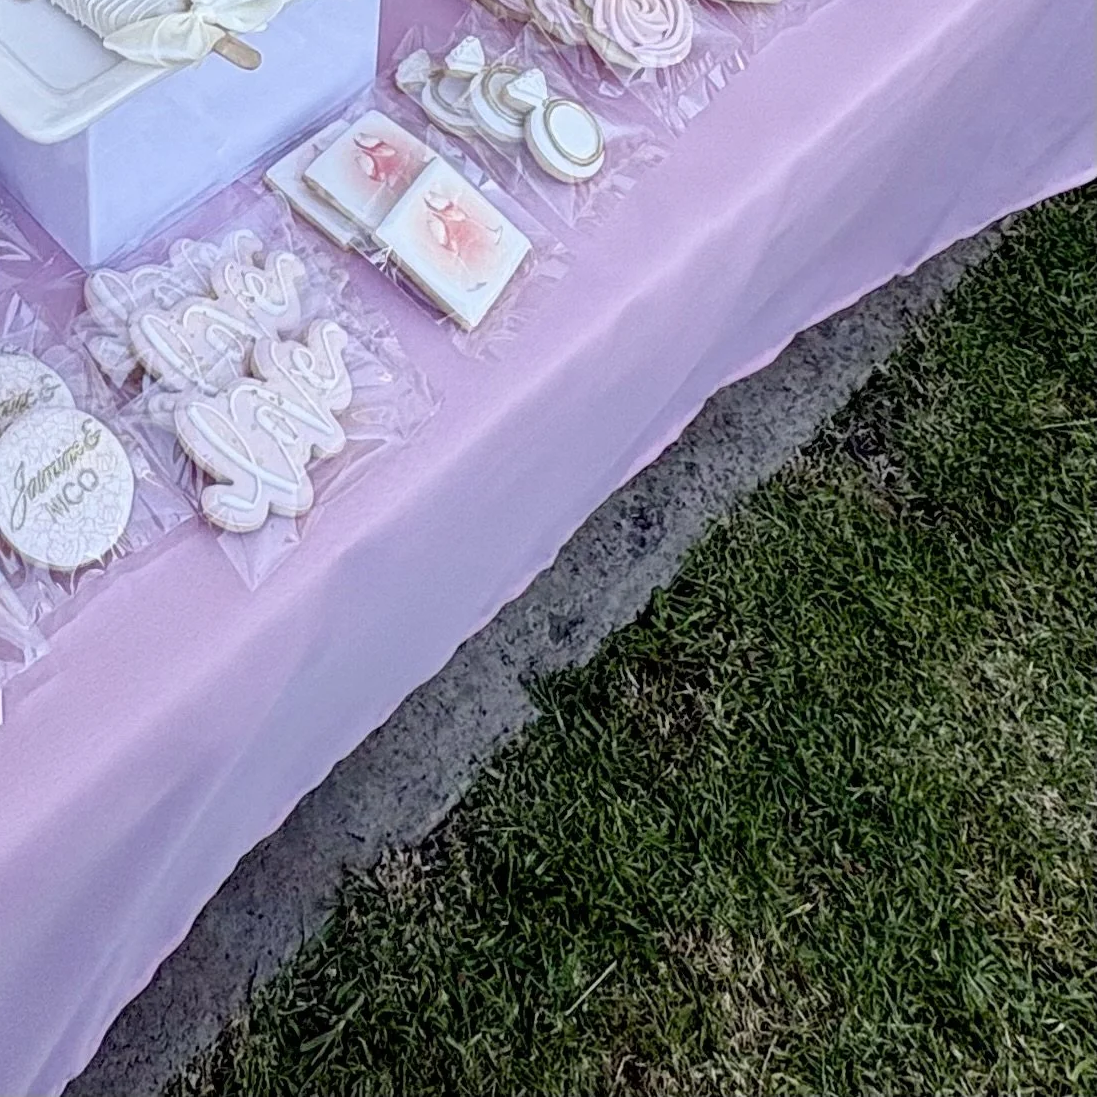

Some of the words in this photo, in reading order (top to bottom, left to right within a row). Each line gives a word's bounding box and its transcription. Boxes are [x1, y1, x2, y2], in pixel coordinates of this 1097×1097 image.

[38, 373, 62, 402] &
[81, 418, 102, 451] &
[46, 468, 100, 519] NICO
